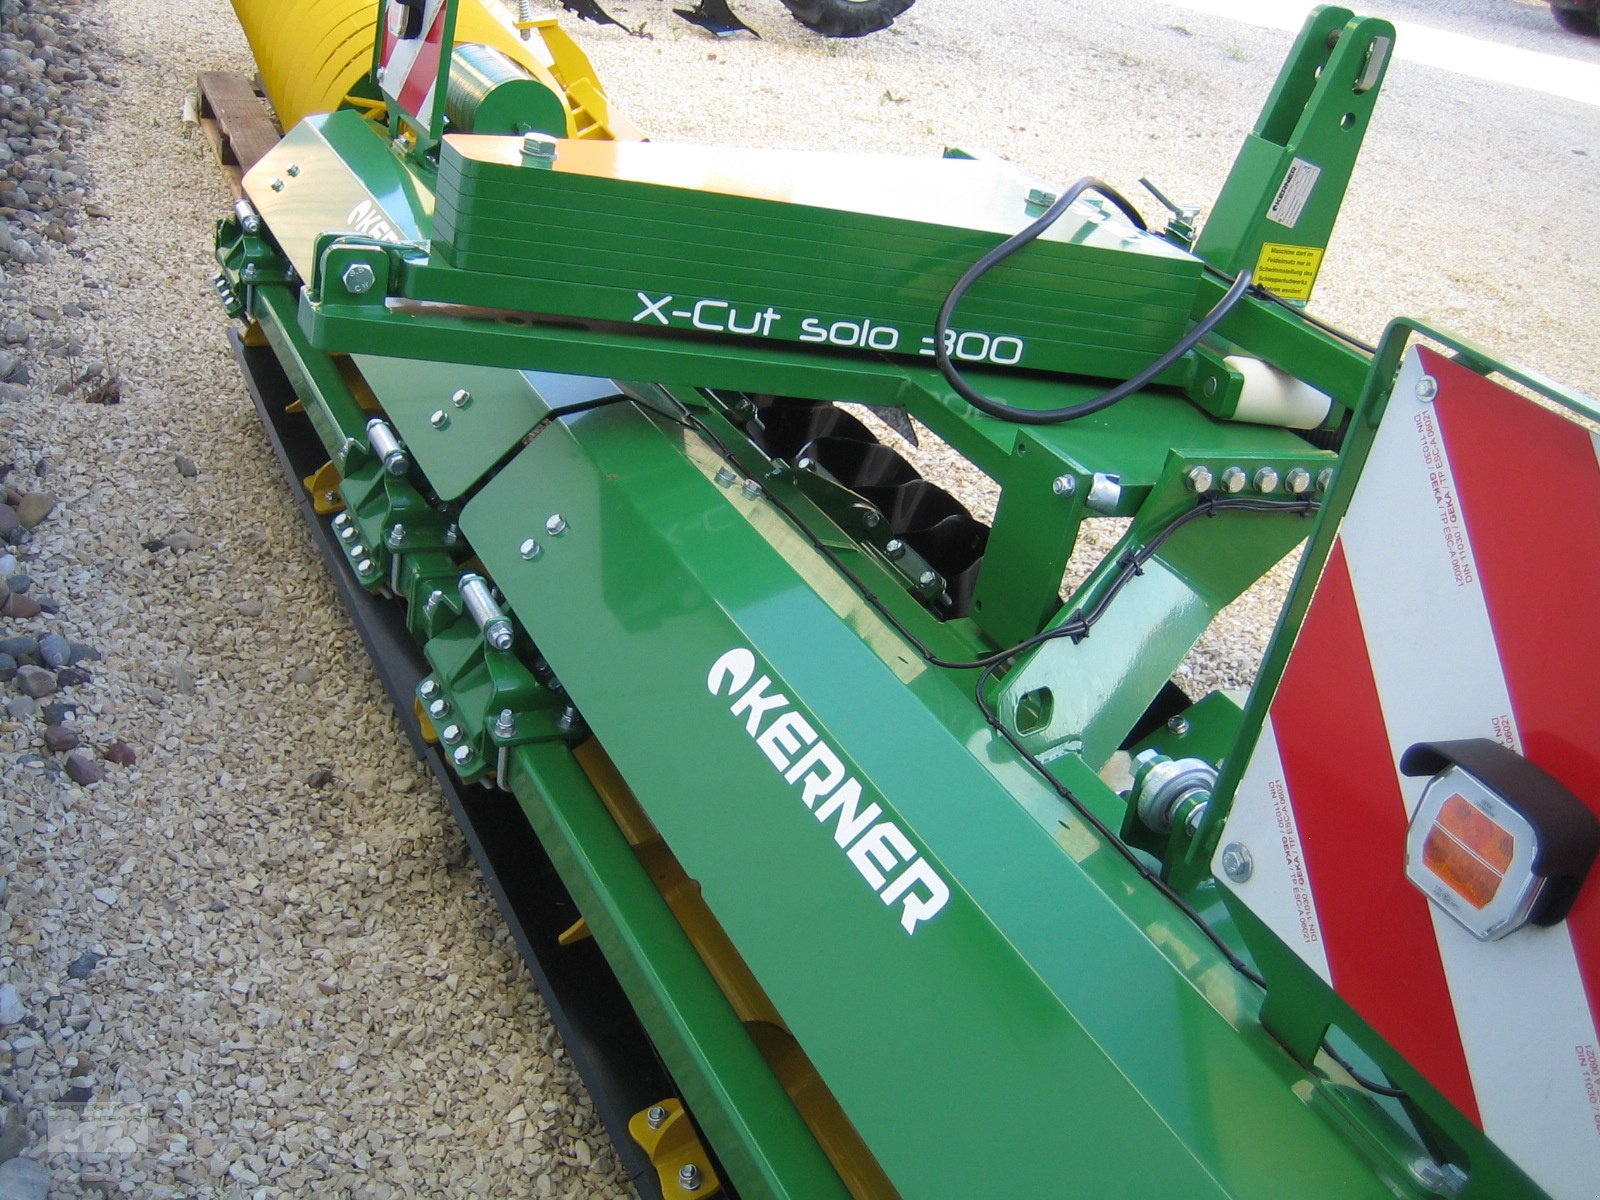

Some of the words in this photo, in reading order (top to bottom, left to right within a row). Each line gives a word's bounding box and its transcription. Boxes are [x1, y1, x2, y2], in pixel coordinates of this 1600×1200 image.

[632, 292, 781, 336] X-Cut
[799, 317, 899, 350] solo
[919, 329, 1024, 365] 300
[1414, 414, 1424, 433] DIN
[1420, 436, 1432, 465] 11030
[1429, 472, 1443, 505] GEKA
[1444, 492, 1457, 523] GEKA
[1454, 532, 1466, 560] 11030
[1492, 717, 1502, 737] DIN
[1500, 715, 1513, 744] 06021
[731, 676, 949, 934] KERNER
[1274, 802, 1283, 828] 11030
[1282, 836, 1292, 865] GEKA
[1294, 856, 1304, 885] GEKA
[1575, 1045, 1587, 1067] DIN
[1582, 1071, 1597, 1104] 11030
